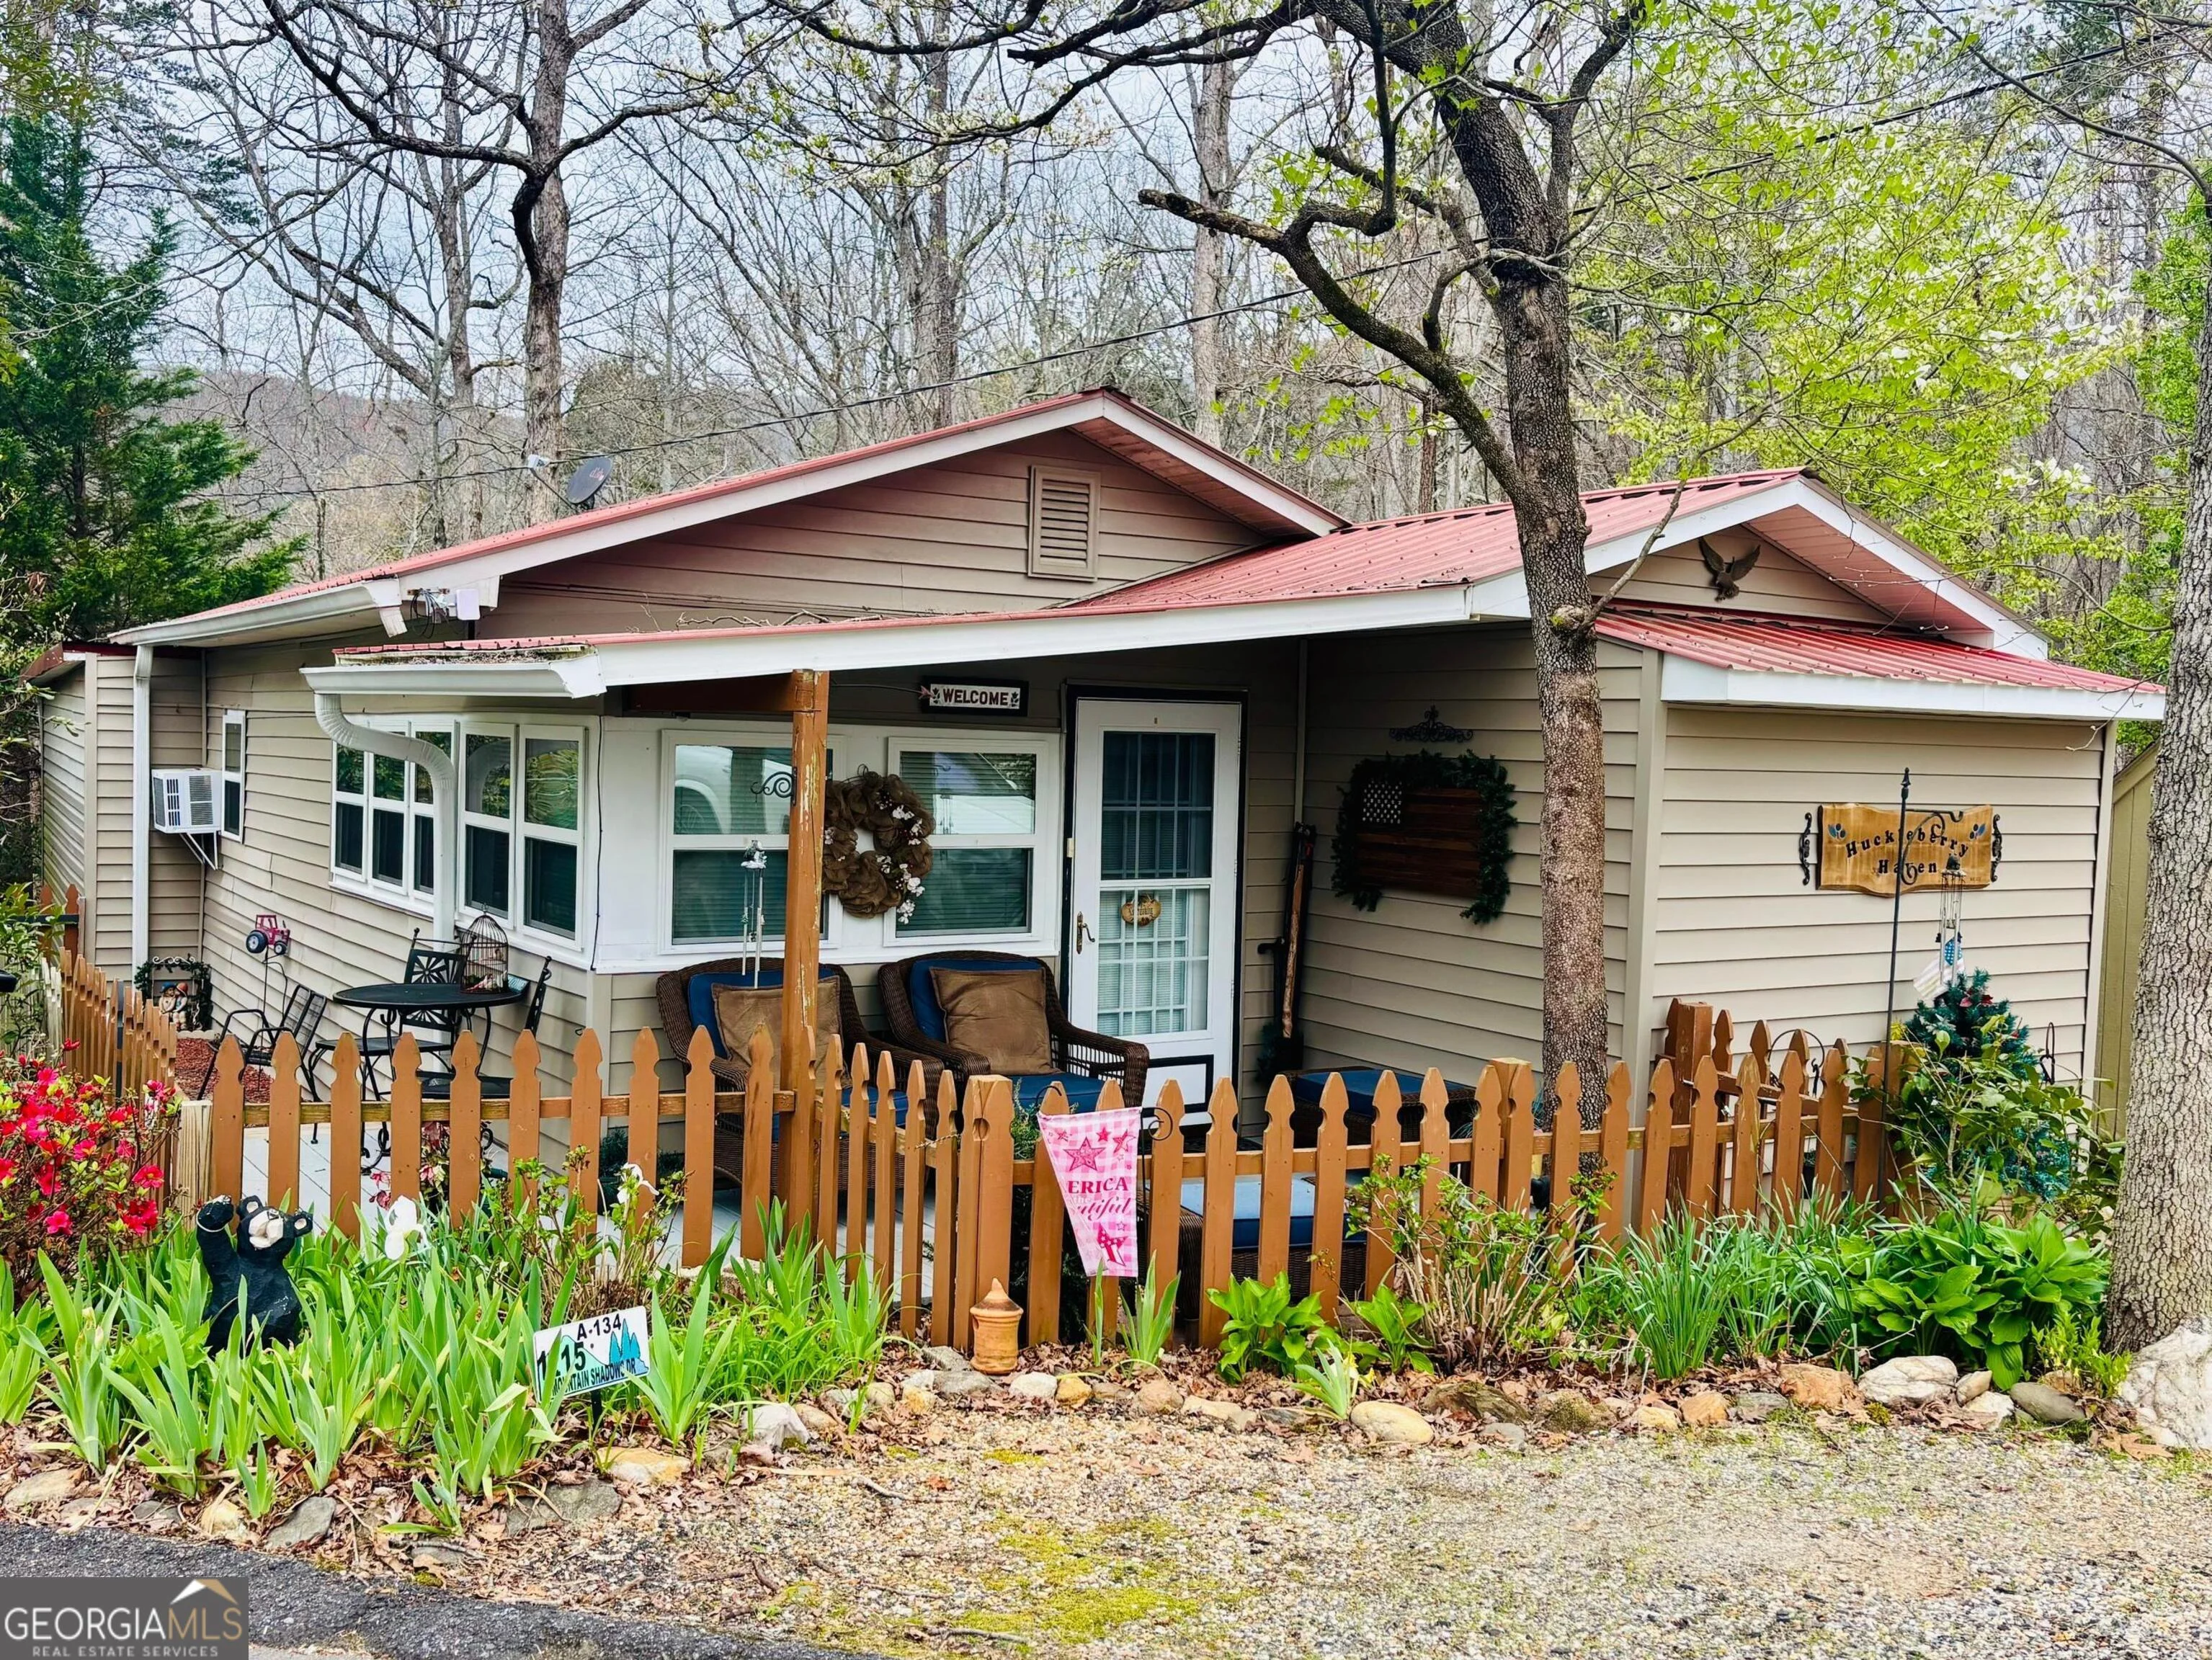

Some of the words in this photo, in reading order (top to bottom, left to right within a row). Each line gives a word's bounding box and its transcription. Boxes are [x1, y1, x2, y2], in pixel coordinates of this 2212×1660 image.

[942, 688, 1009, 706] WELCOME
[1846, 827, 1969, 858] Huckeberry
[1068, 1177, 1128, 1194] ERICA
[577, 1313, 622, 1341] A-134
[537, 1342, 586, 1381] 115
[626, 1357, 636, 1375] DR
